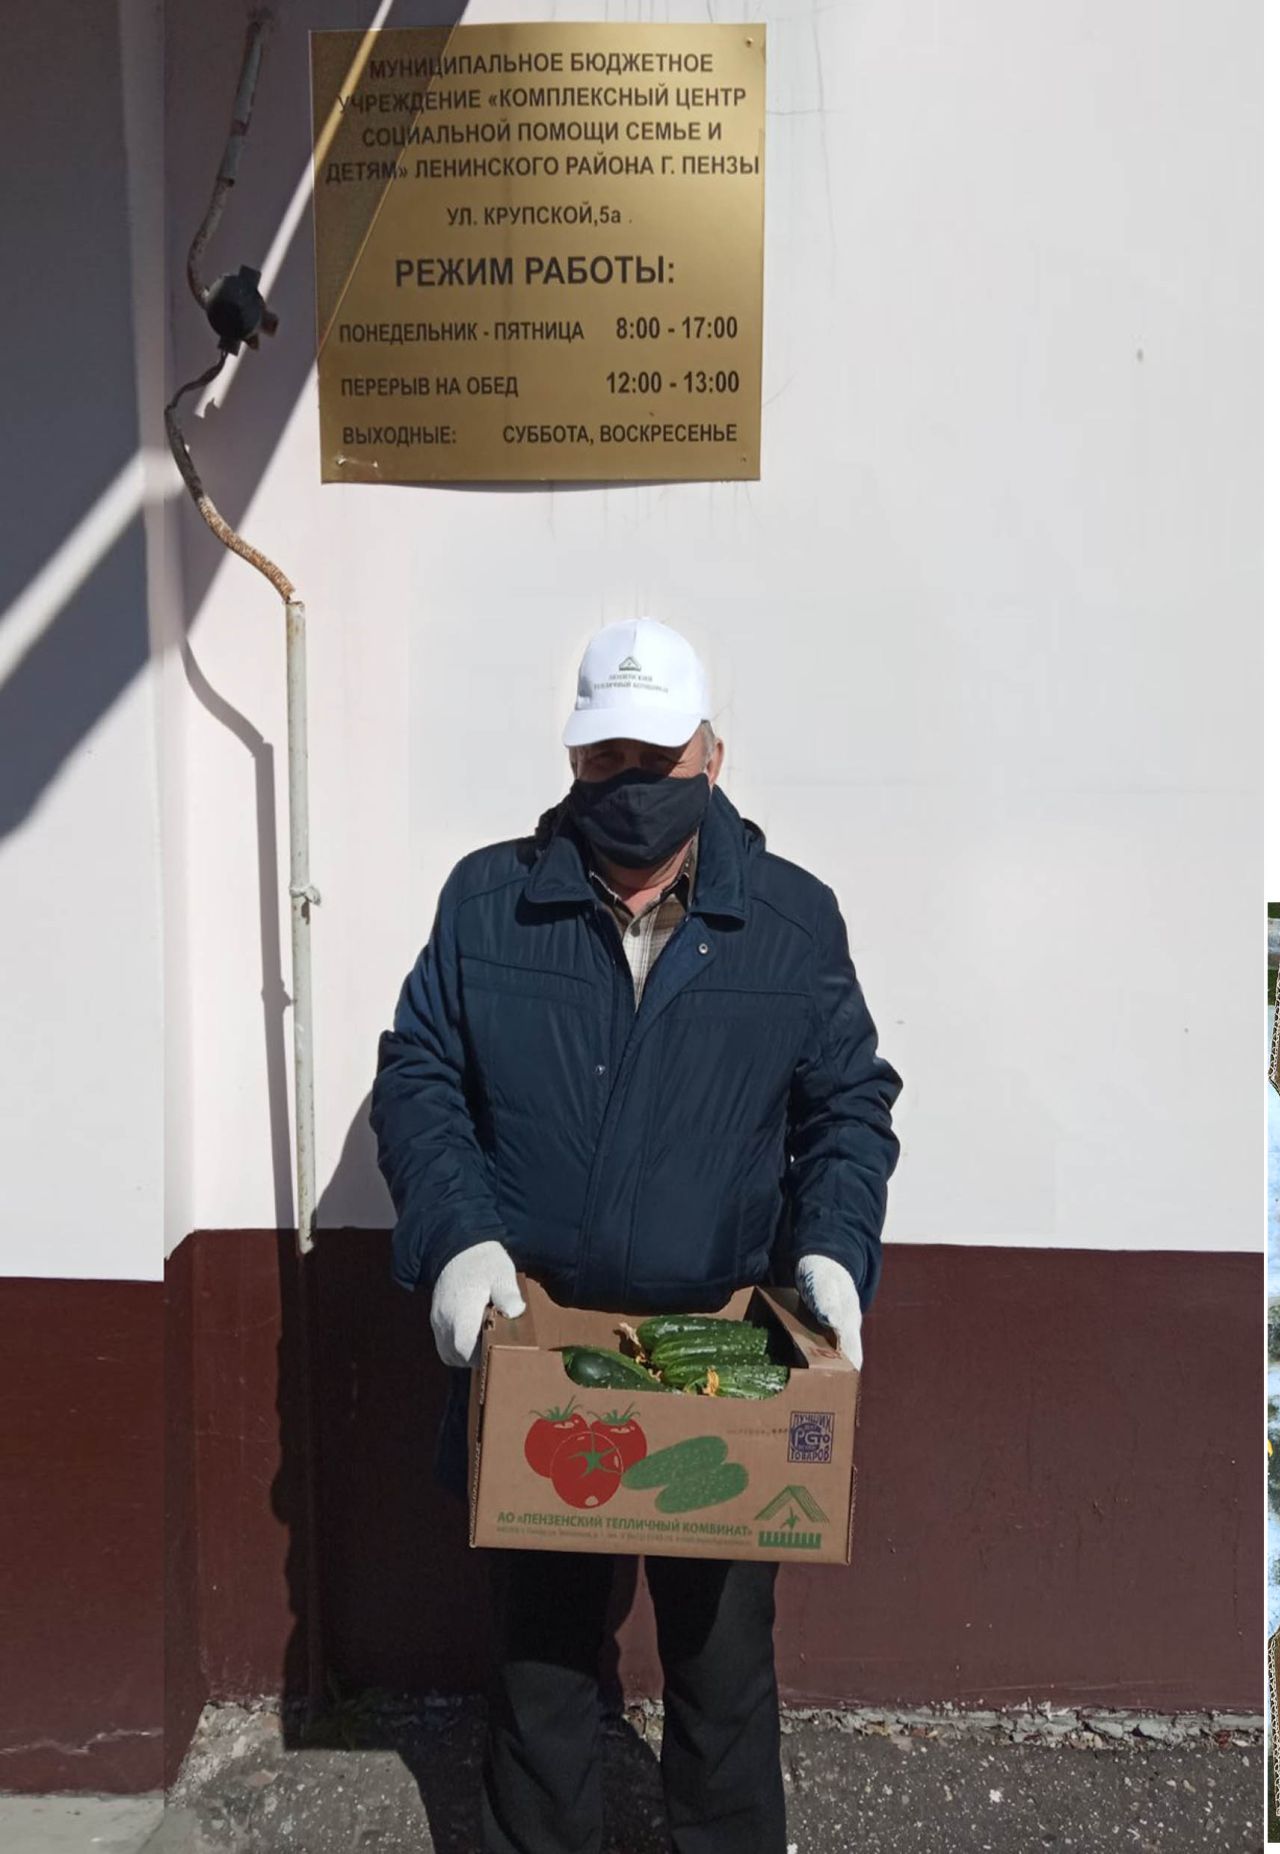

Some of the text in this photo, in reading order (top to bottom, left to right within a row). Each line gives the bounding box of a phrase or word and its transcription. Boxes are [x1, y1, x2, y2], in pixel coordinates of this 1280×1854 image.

[369, 52, 714, 78] МУНИЦИПАЛЬНОЕ БЮДЖЕТНОЕ
[340, 83, 746, 114] УЧРЕЖДЕНИЕ «КОМПЛЕКСНЫЙ ЦЕНТР
[362, 119, 722, 148] СОЦИАЛЬНОЙ ПОМОЩИ СЕМЬЕ И
[326, 152, 760, 184] ДЕТЯМ» ЛЕНИНСКОГО РАЙОНА Г. ПЕНЗЫ
[446, 201, 622, 227] УЛ. КРУПСКОЙ,5а
[395, 254, 675, 288] РЕЖИМ РАБОТЫ:
[339, 322, 478, 345] ПОНЕДЕЛЬНИК
[494, 321, 585, 343] ПЯТНИЦА
[615, 316, 661, 340] 8:00
[681, 315, 738, 340] 17:00
[341, 377, 431, 396] ПЕРЕРЫВ
[435, 377, 462, 395] НА
[466, 377, 519, 398] ОБЕД
[606, 371, 663, 394] 12:00
[683, 370, 740, 394] 13:00
[342, 423, 738, 446] ВЫХОДНЫЕ: СУББОТА, ВОСКРЕСЕНЬЕ
[498, 1511, 515, 1523] АО
[606, 1517, 680, 1532] ТЕПЛИЧНЫЙ
[683, 1521, 752, 1536] КОМБИНАТ»
